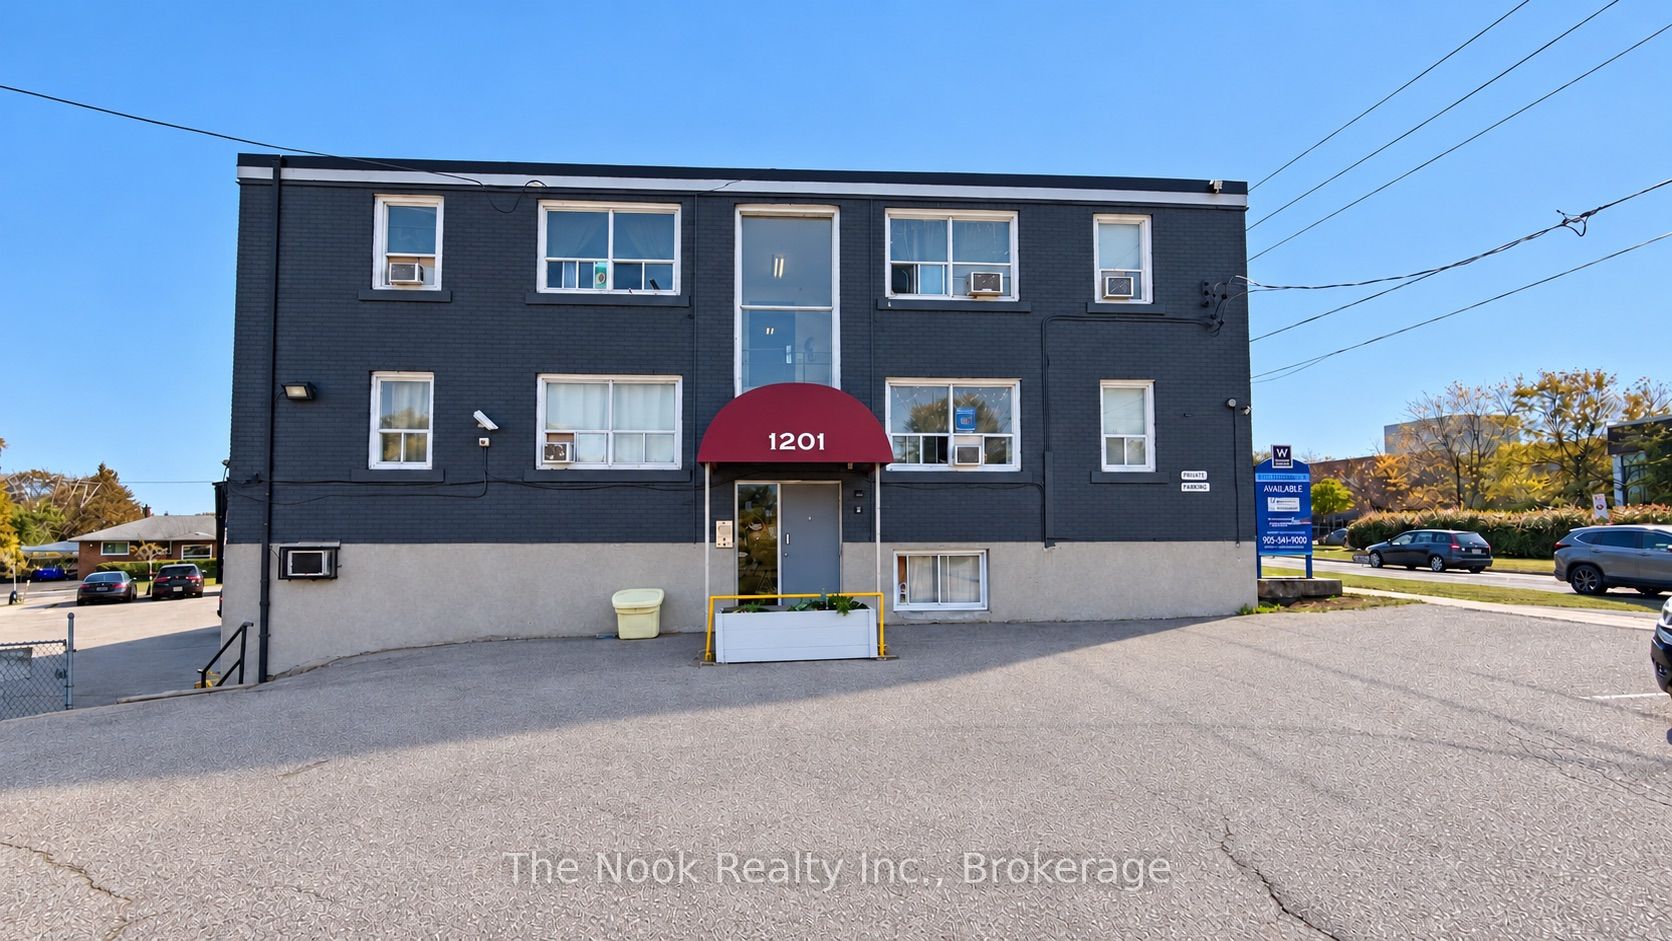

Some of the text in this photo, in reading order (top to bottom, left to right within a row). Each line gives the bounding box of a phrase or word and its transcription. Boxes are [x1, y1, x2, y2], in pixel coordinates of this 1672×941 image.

[769, 432, 825, 450] 1201
[1276, 448, 1288, 458] W
[1263, 485, 1303, 493] AVAILABLE
